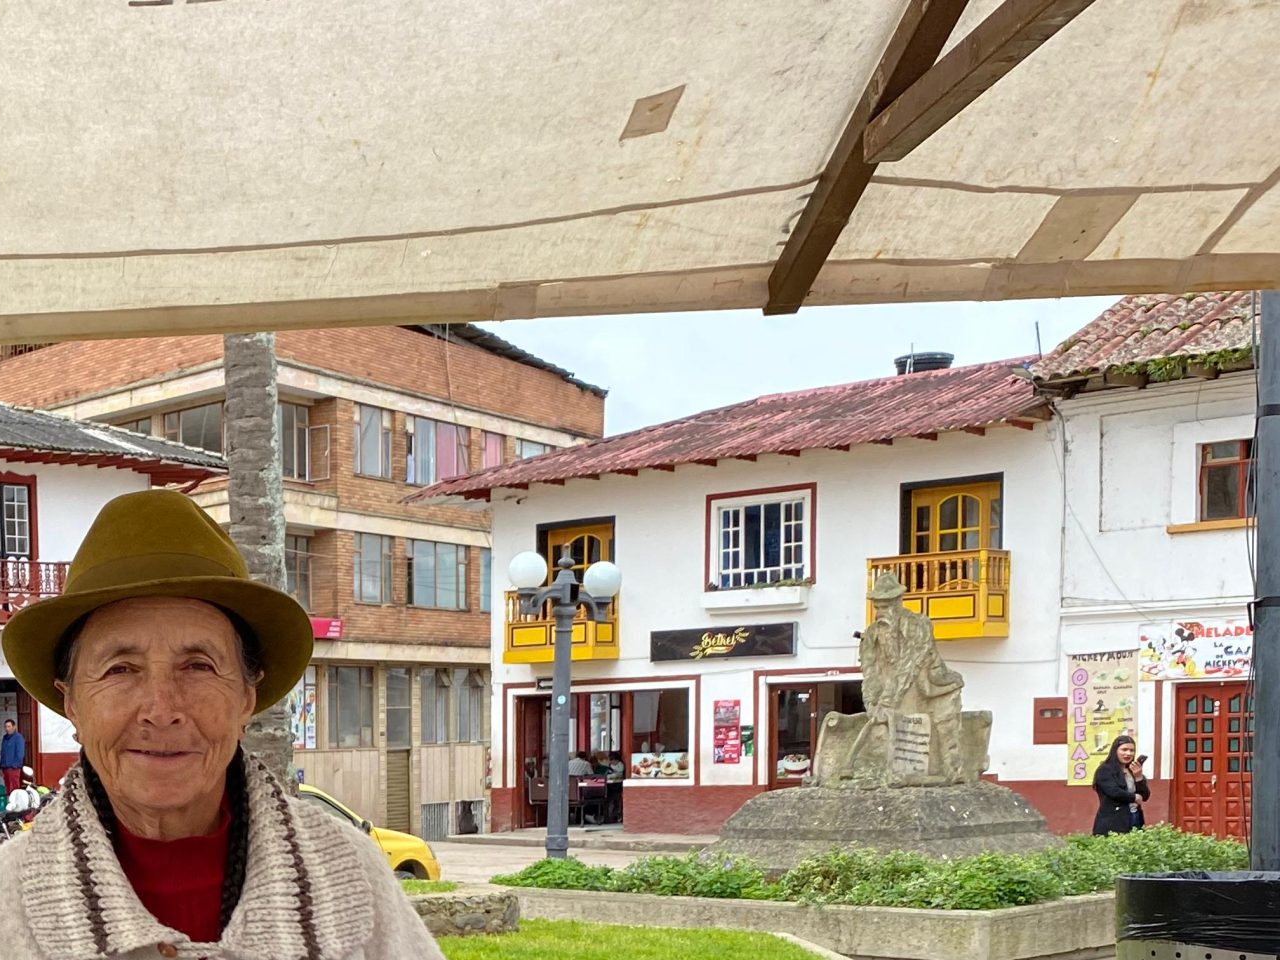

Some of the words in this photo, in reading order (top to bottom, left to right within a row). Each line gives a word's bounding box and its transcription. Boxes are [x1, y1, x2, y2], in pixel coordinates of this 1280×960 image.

[702, 632, 737, 648] Bethel
[1224, 645, 1252, 656] CAS
[1071, 667, 1090, 780] OBLEAS
